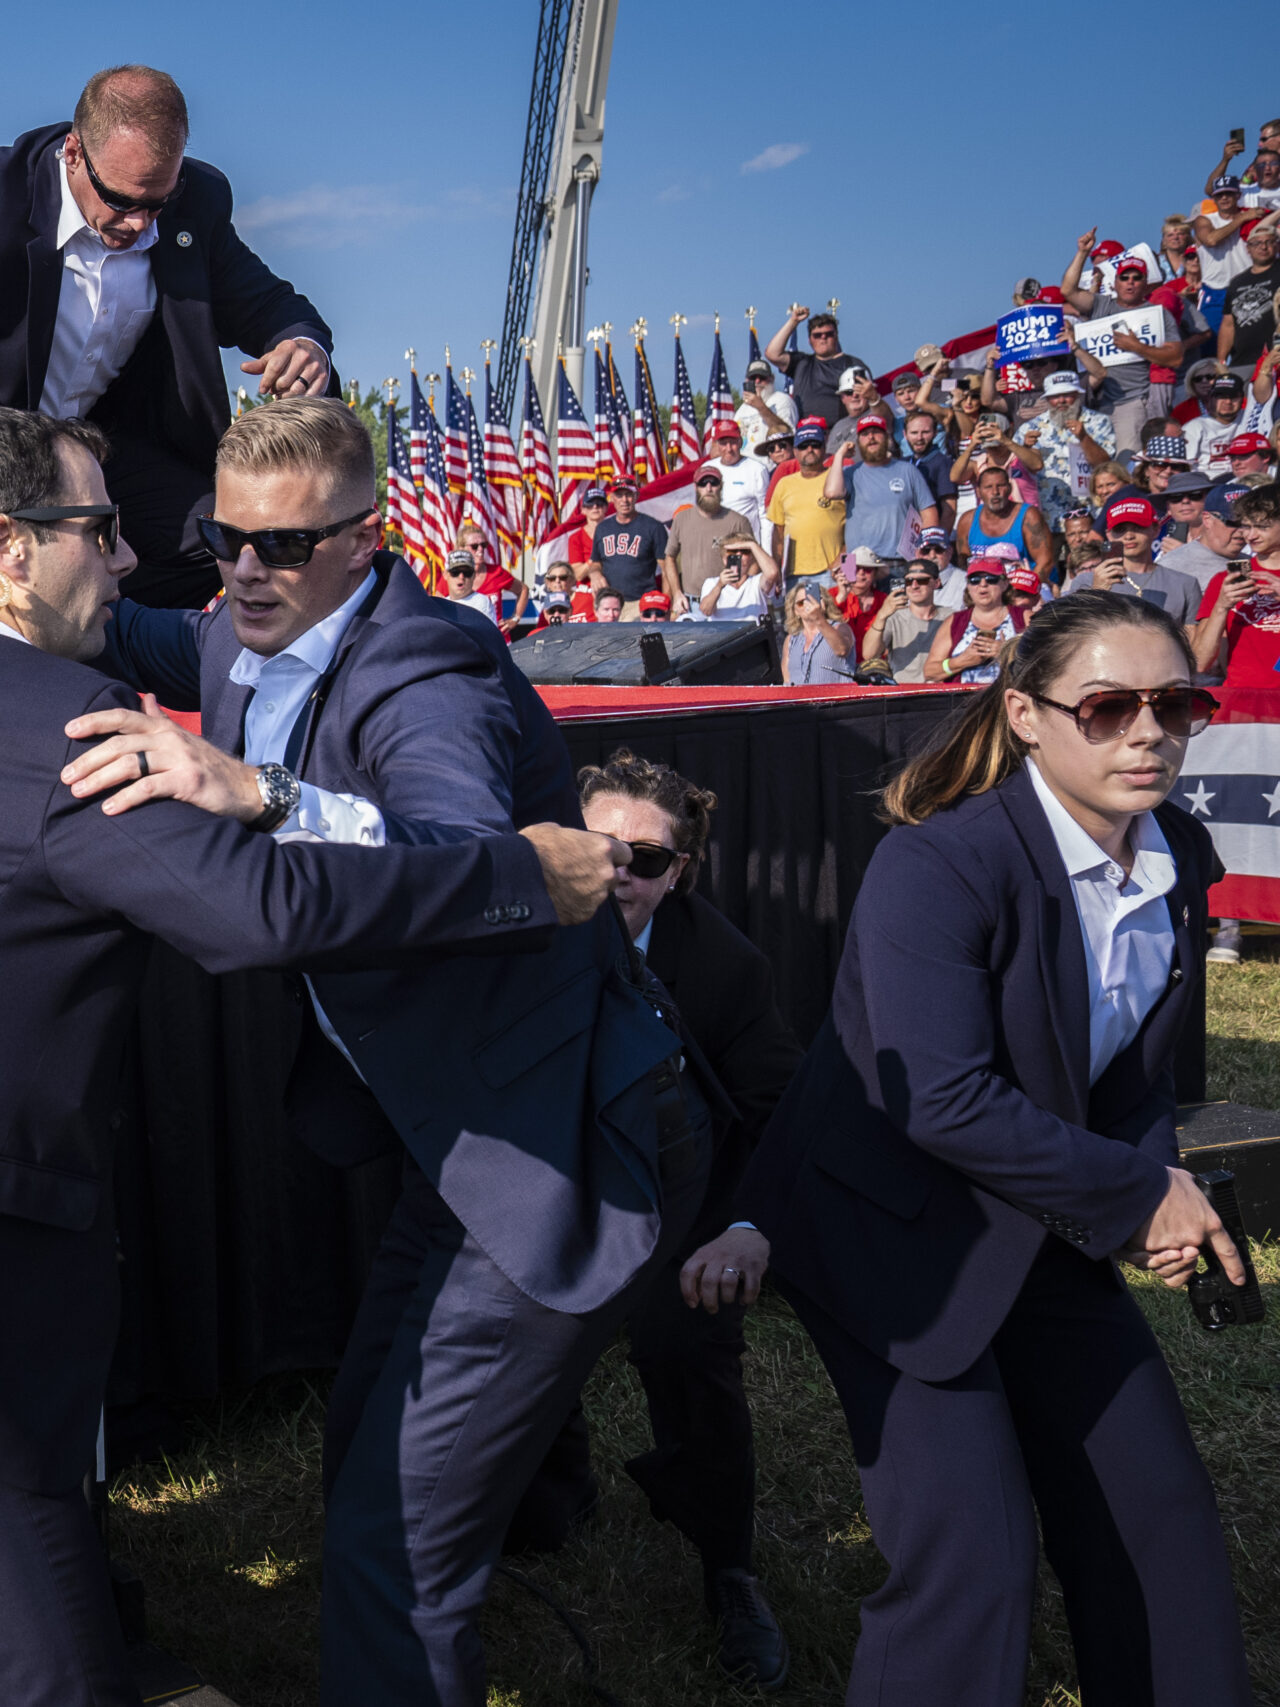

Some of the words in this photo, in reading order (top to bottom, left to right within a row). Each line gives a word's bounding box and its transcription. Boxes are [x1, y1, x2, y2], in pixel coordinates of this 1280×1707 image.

[1001, 315, 1058, 338] TRUMP
[1005, 327, 1050, 348] 2024
[603, 533, 642, 558] USA
